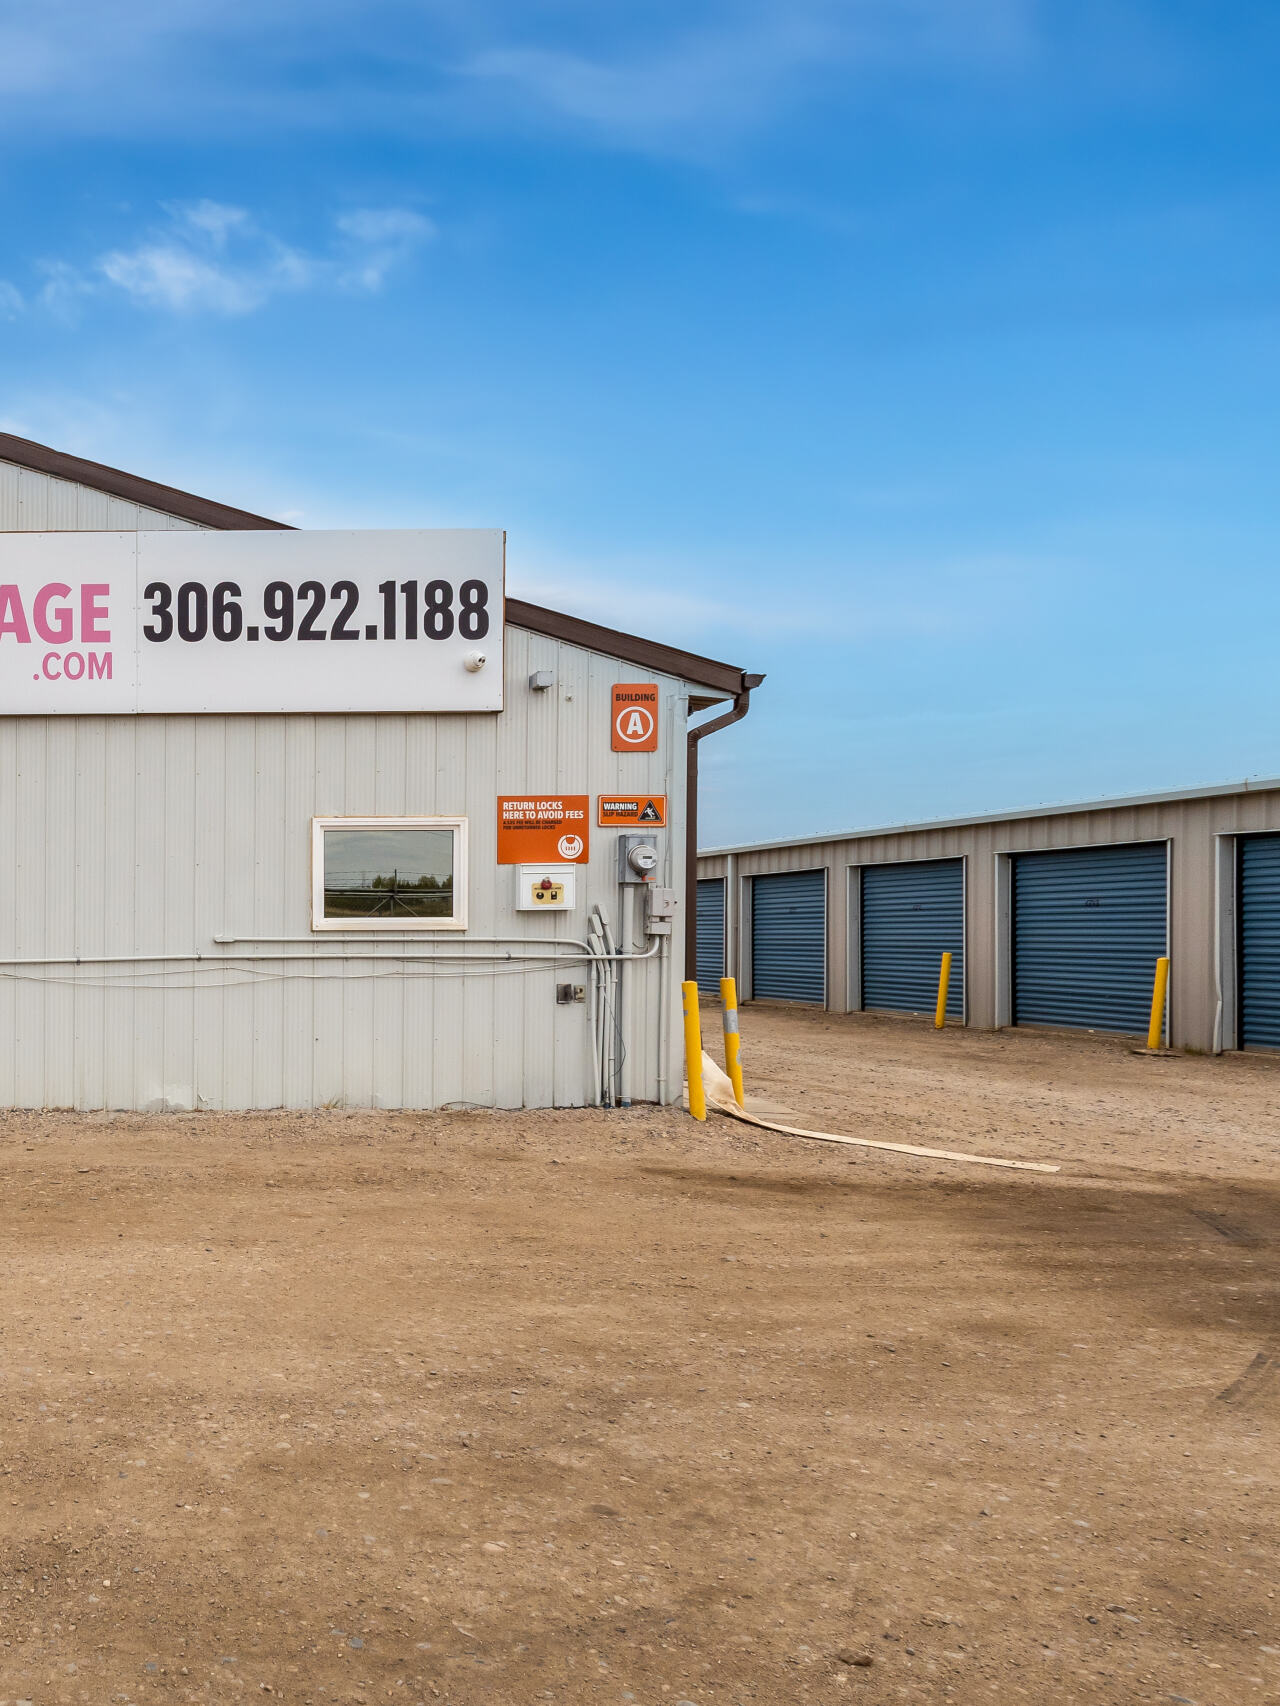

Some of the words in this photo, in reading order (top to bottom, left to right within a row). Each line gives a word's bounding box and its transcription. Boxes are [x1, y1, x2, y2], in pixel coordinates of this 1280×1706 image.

[143, 579, 490, 643] 306.922.1188
[32, 651, 114, 681] .COM
[615, 693, 656, 702] BUILDING
[626, 712, 644, 735] A
[503, 801, 535, 810] RETURN
[536, 801, 563, 810] LOCKS
[603, 802, 638, 810] WARNING
[503, 811, 524, 819] HERE
[525, 811, 536, 819] TO
[537, 810, 564, 819] AVOID
[565, 810, 584, 819] FEES
